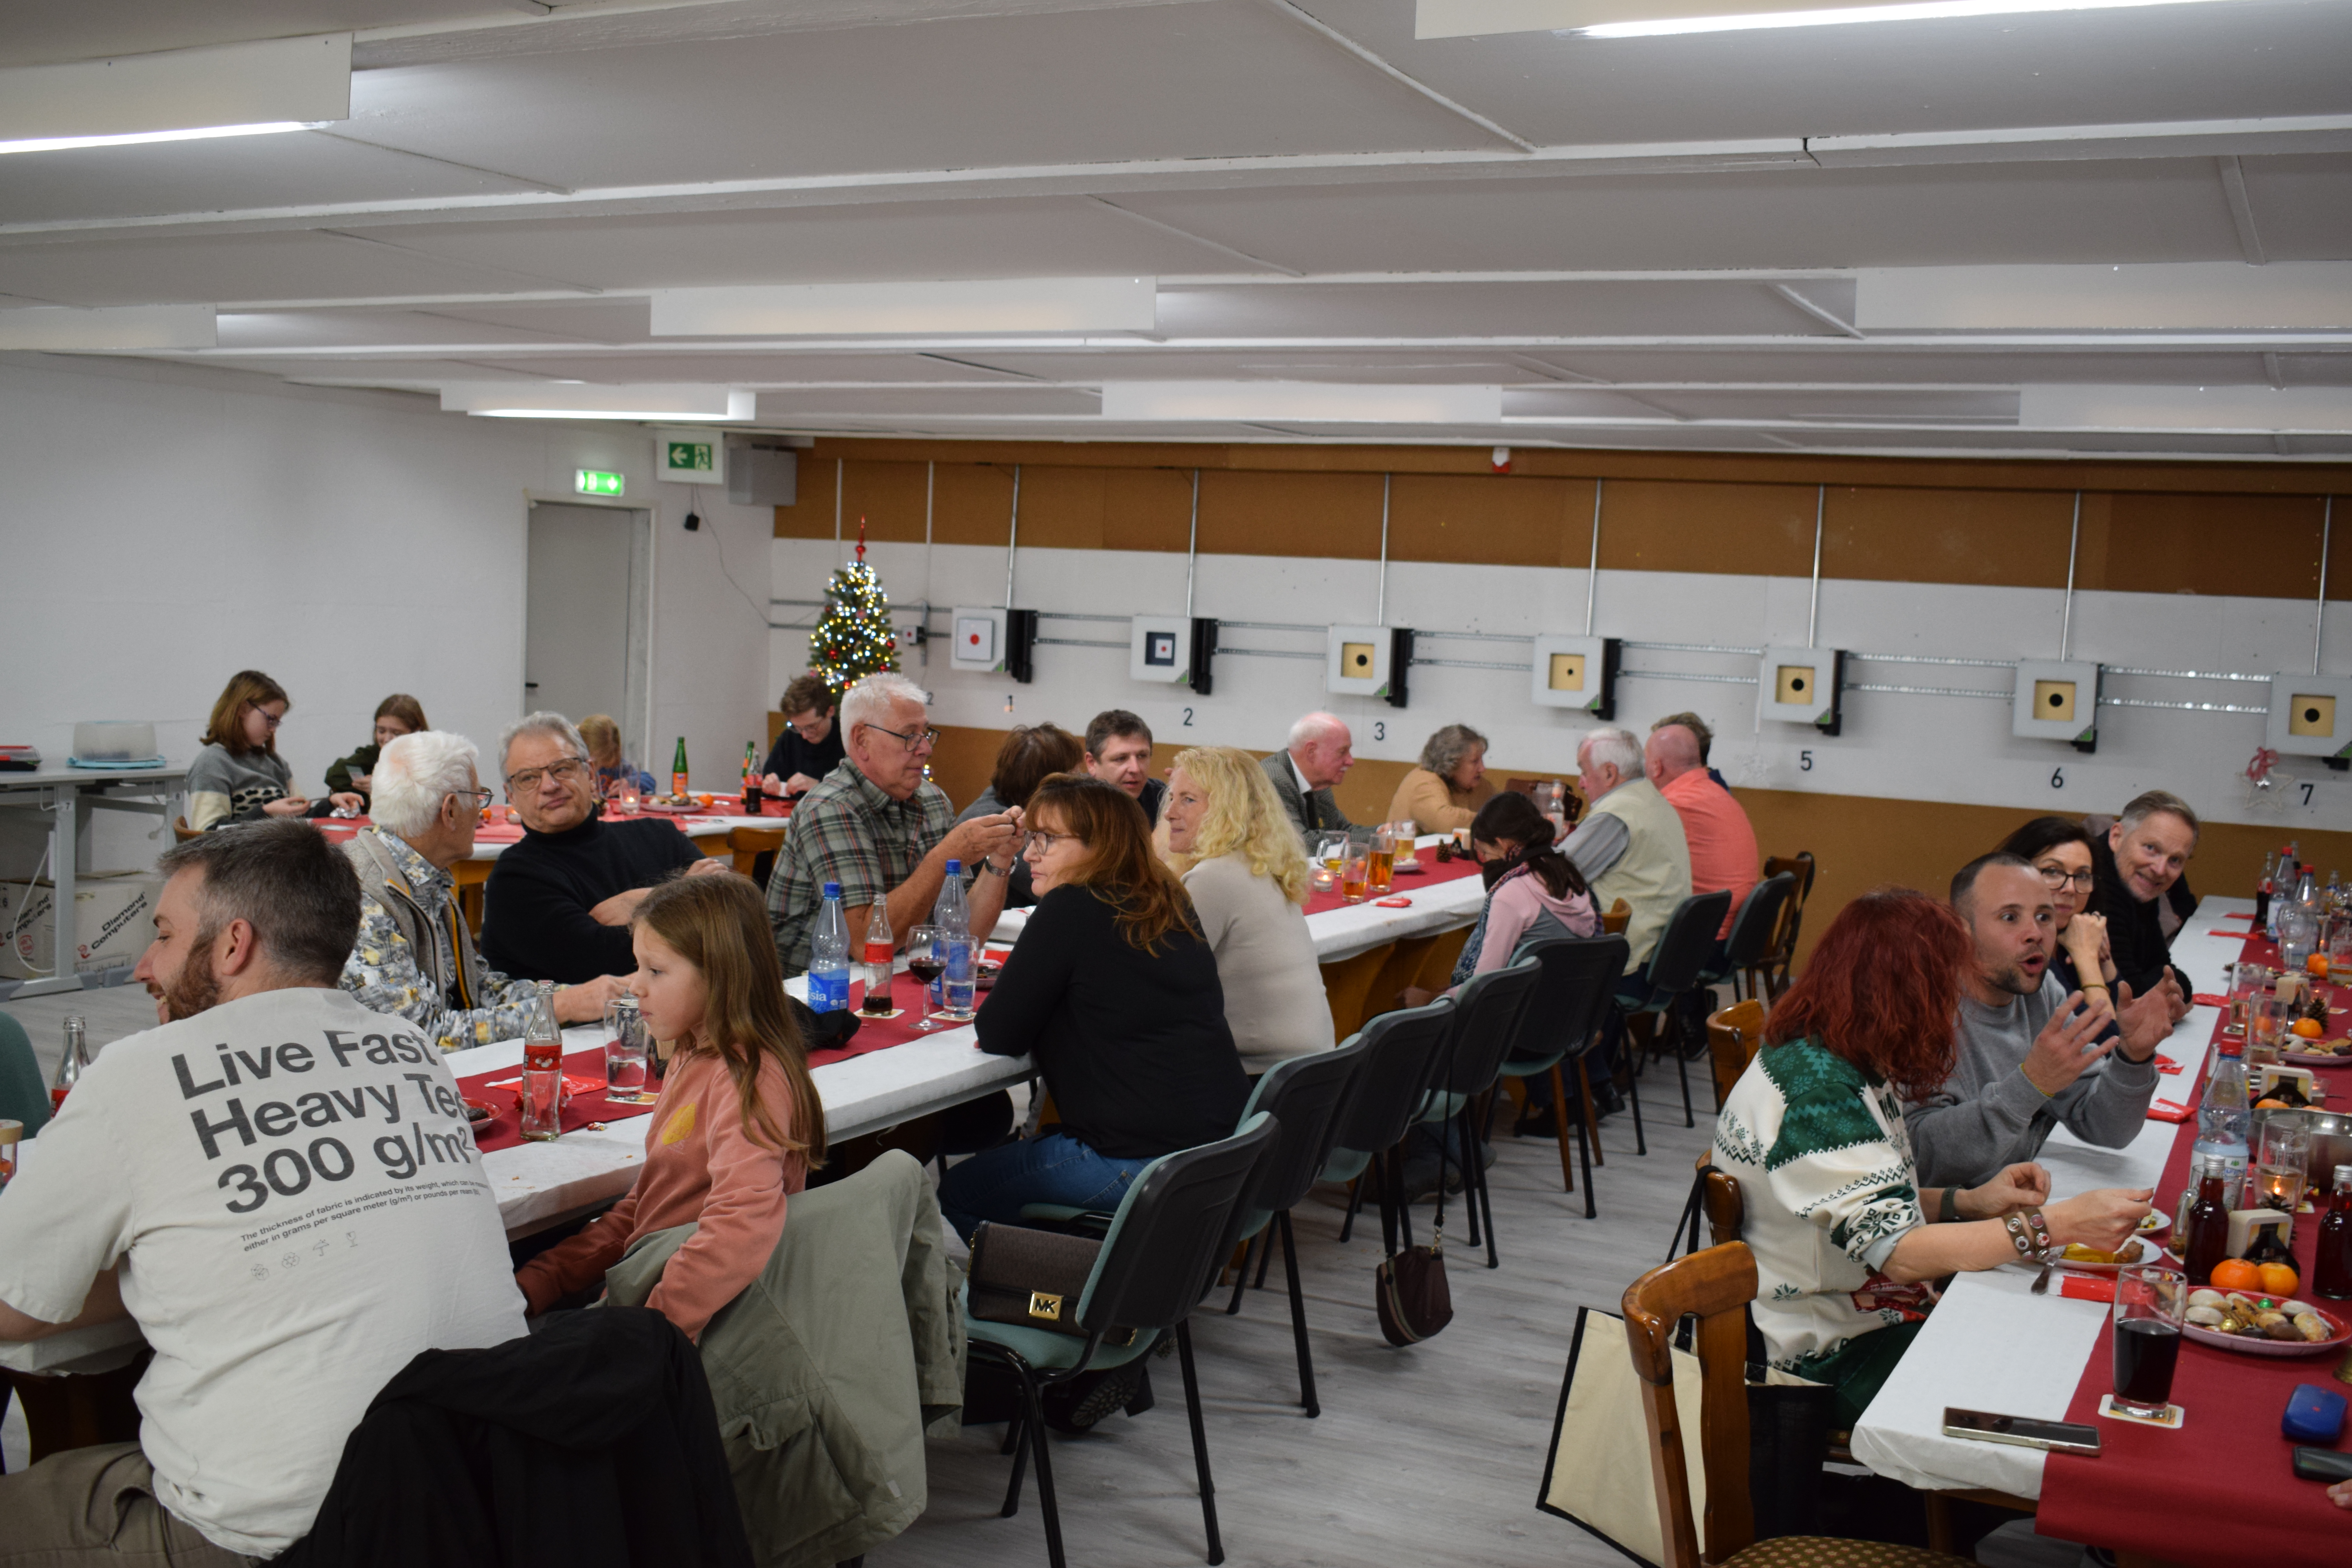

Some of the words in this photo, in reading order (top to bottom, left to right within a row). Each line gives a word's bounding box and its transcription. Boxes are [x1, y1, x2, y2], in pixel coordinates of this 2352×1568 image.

[926, 692, 934, 705] 2
[1008, 695, 1013, 712] 1
[1183, 707, 1193, 726] 2
[1374, 722, 1384, 741] 3
[1801, 750, 1812, 771] 5
[2051, 767, 2063, 788] 6
[2301, 784, 2314, 806] 7
[102, 892, 145, 932] Diamond
[91, 902, 147, 949] Computers
[172, 1043, 314, 1099] Live
[323, 1030, 438, 1067] Fast
[191, 1085, 401, 1160] Heavy
[218, 1137, 354, 1213] 300
[241, 1232, 258, 1242] The
[260, 1215, 303, 1234] thickness
[306, 1209, 315, 1218] of
[317, 1202, 343, 1214] fabric
[355, 1189, 392, 1203] indicated
[416, 1181, 441, 1190] weight,
[244, 1239, 269, 1252] either
[283, 1223, 312, 1238] grams
[314, 1217, 328, 1228] per
[332, 1208, 361, 1220] square
[363, 1200, 387, 1211] meter
[423, 1190, 448, 1200] pounds
[1035, 1298, 1057, 1314] MK
